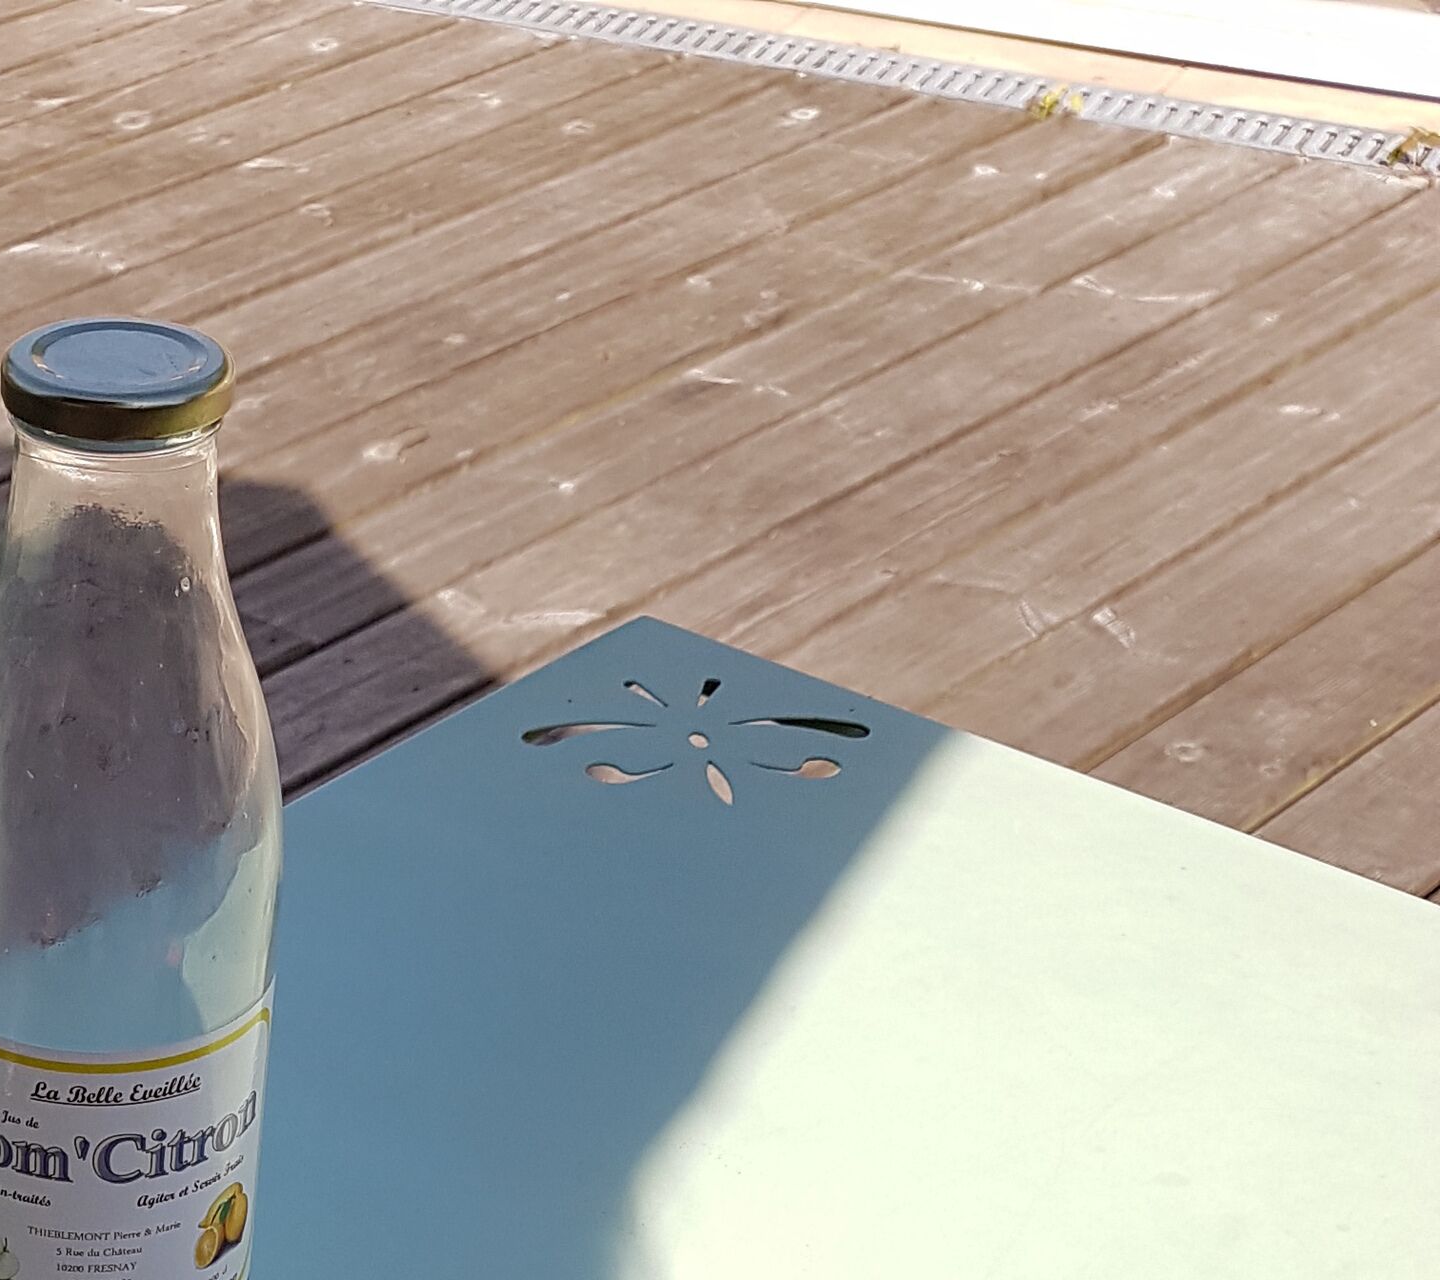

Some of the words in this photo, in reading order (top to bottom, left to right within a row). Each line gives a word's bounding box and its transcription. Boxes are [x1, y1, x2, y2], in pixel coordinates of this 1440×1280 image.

[31, 1082, 59, 1100] La
[67, 1086, 123, 1103] Belle
[130, 1073, 201, 1101] Eveillée
[1, 1110, 21, 1124] Jus
[25, 1117, 40, 1129] de
[137, 1193, 175, 1208] Agiter
[179, 1186, 189, 1197] et
[27, 1226, 110, 1241] THIEBLEMONT
[113, 1230, 141, 1241] Pierre
[144, 1227, 152, 1236] &
[155, 1222, 181, 1233] Marie
[66, 1248, 84, 1257] Rue
[87, 1248, 99, 1257] du
[103, 1246, 142, 1257] Château
[57, 1263, 84, 1273] 10200
[88, 1261, 137, 1273] FRESNAY
